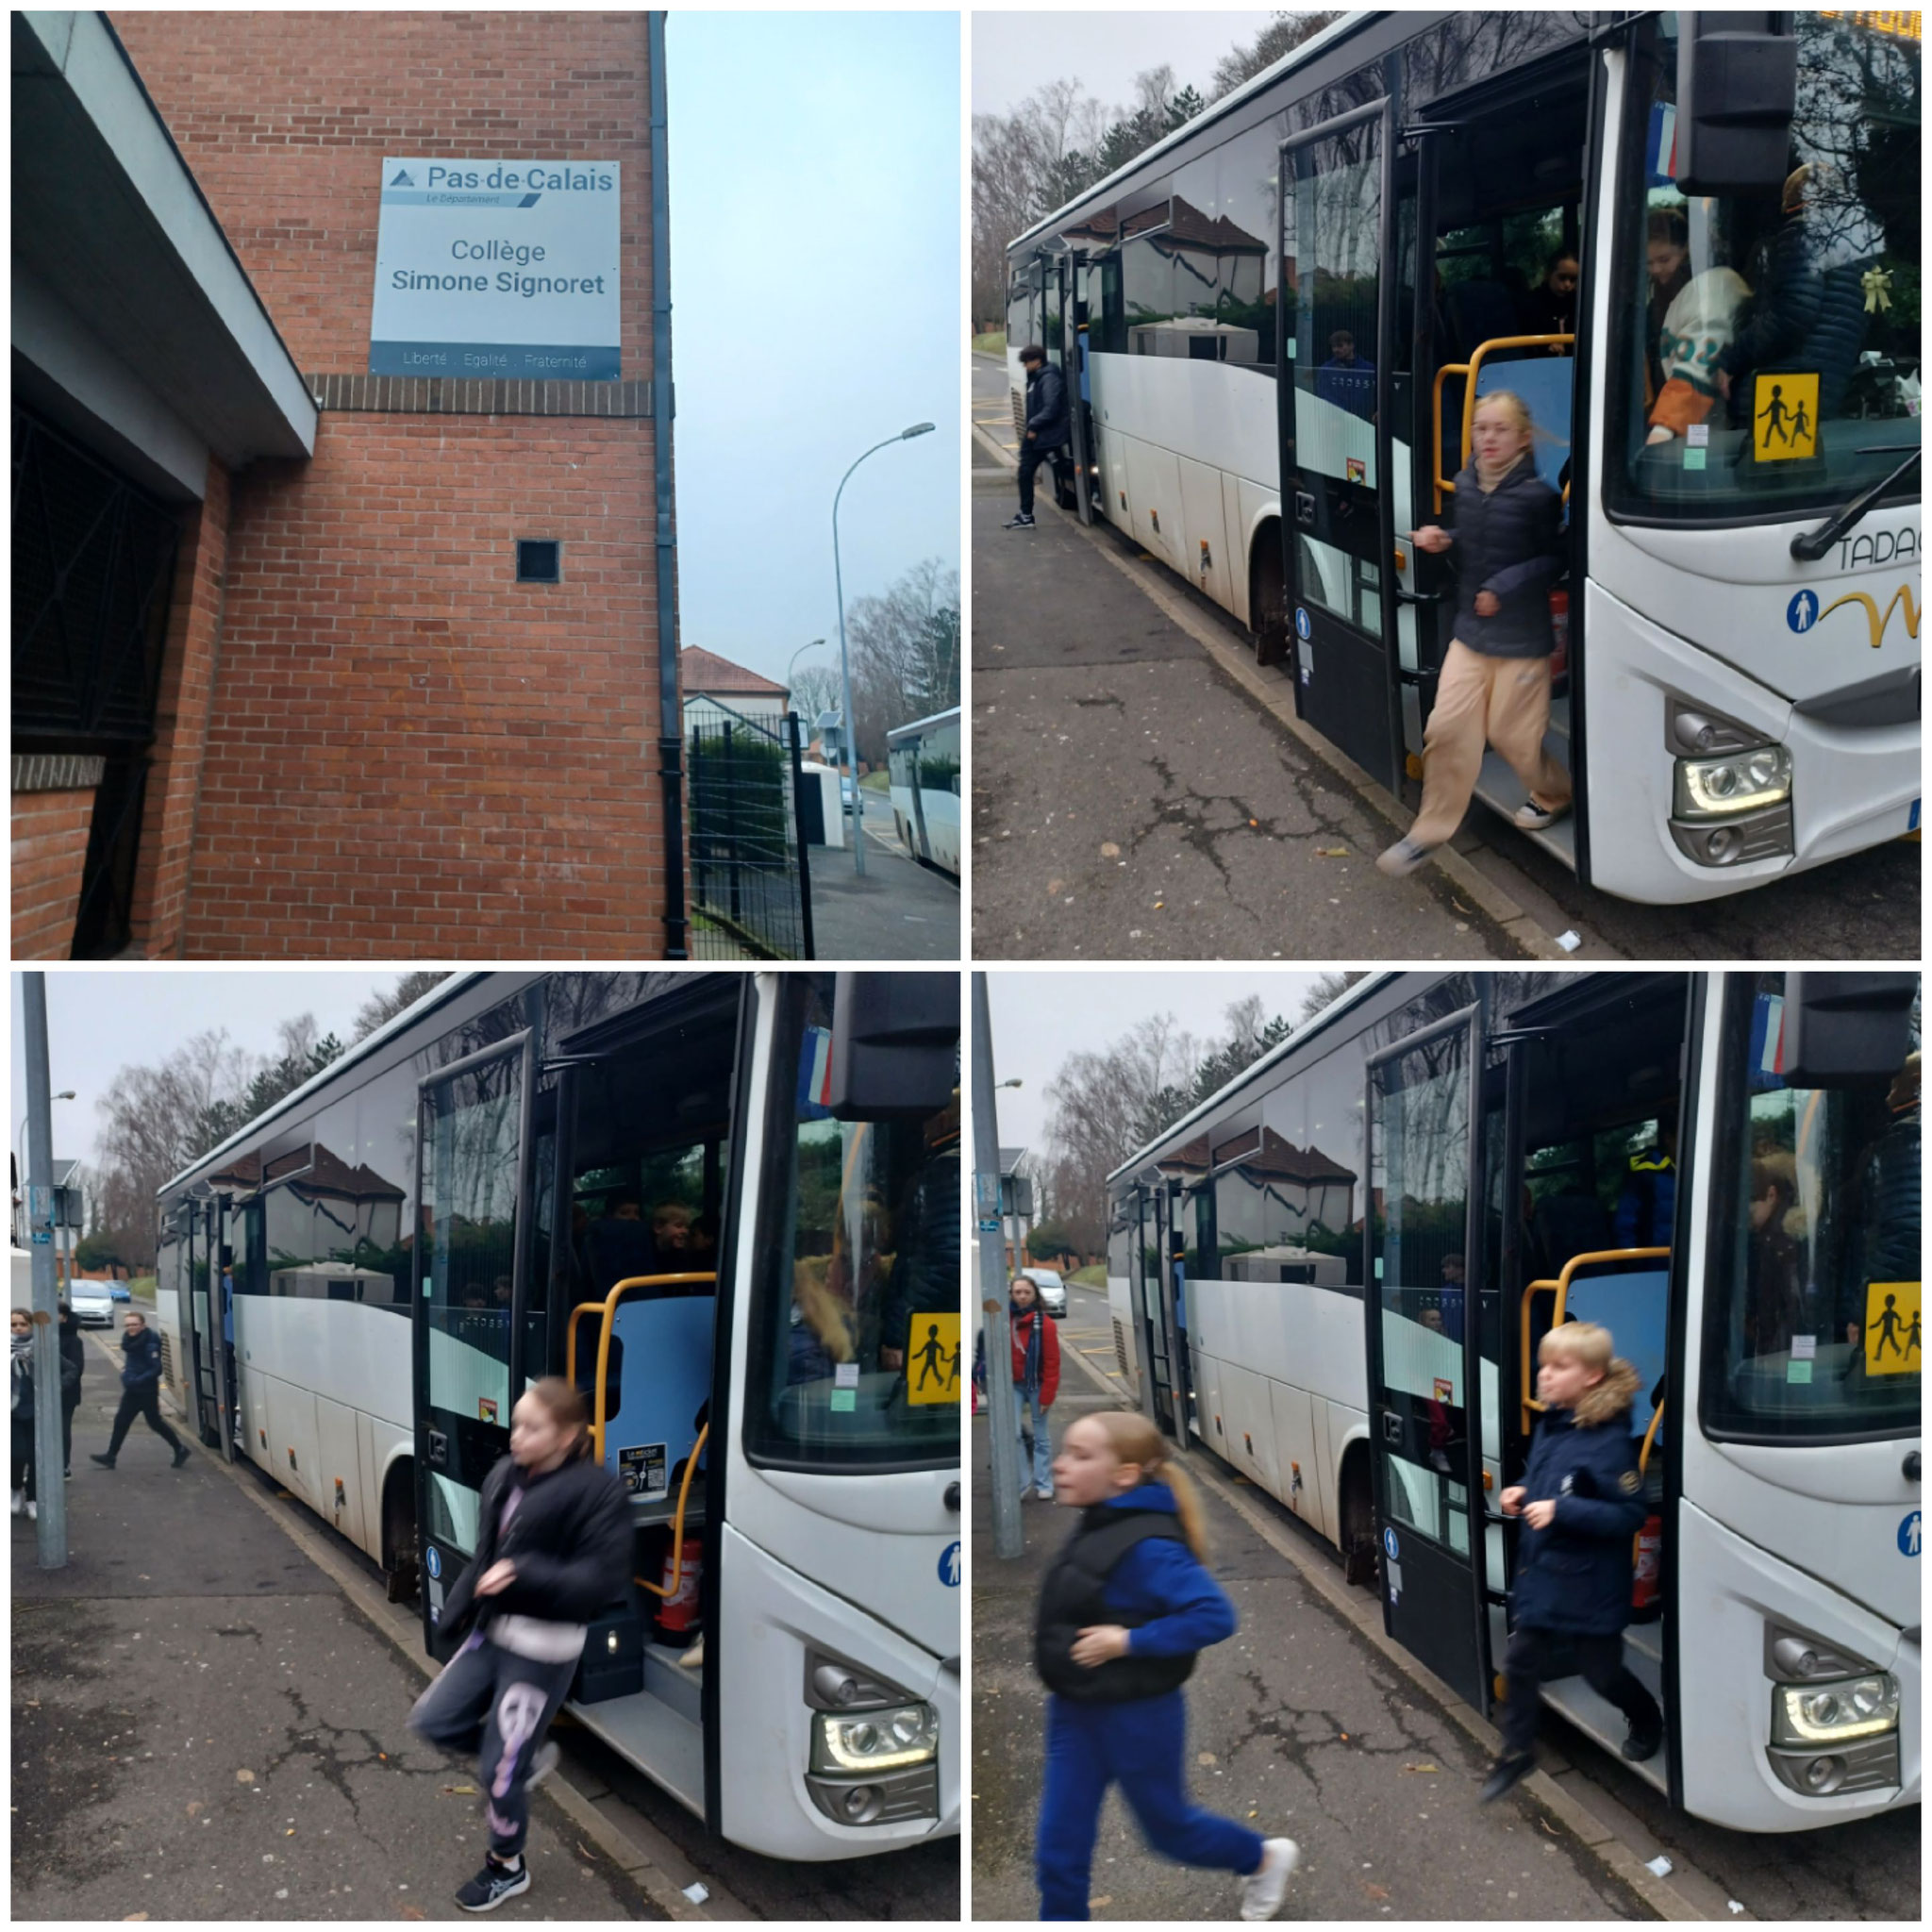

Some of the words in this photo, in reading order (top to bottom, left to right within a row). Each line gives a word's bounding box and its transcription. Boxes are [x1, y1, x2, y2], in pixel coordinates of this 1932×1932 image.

[426, 193, 439, 203] Le
[440, 193, 500, 205] Département
[451, 240, 546, 266] Collège
[391, 270, 489, 291] Simone
[495, 272, 605, 298] Signoret
[403, 351, 447, 365] Liberté
[525, 354, 587, 369] Fraternité
[1839, 527, 1922, 570] TADA
